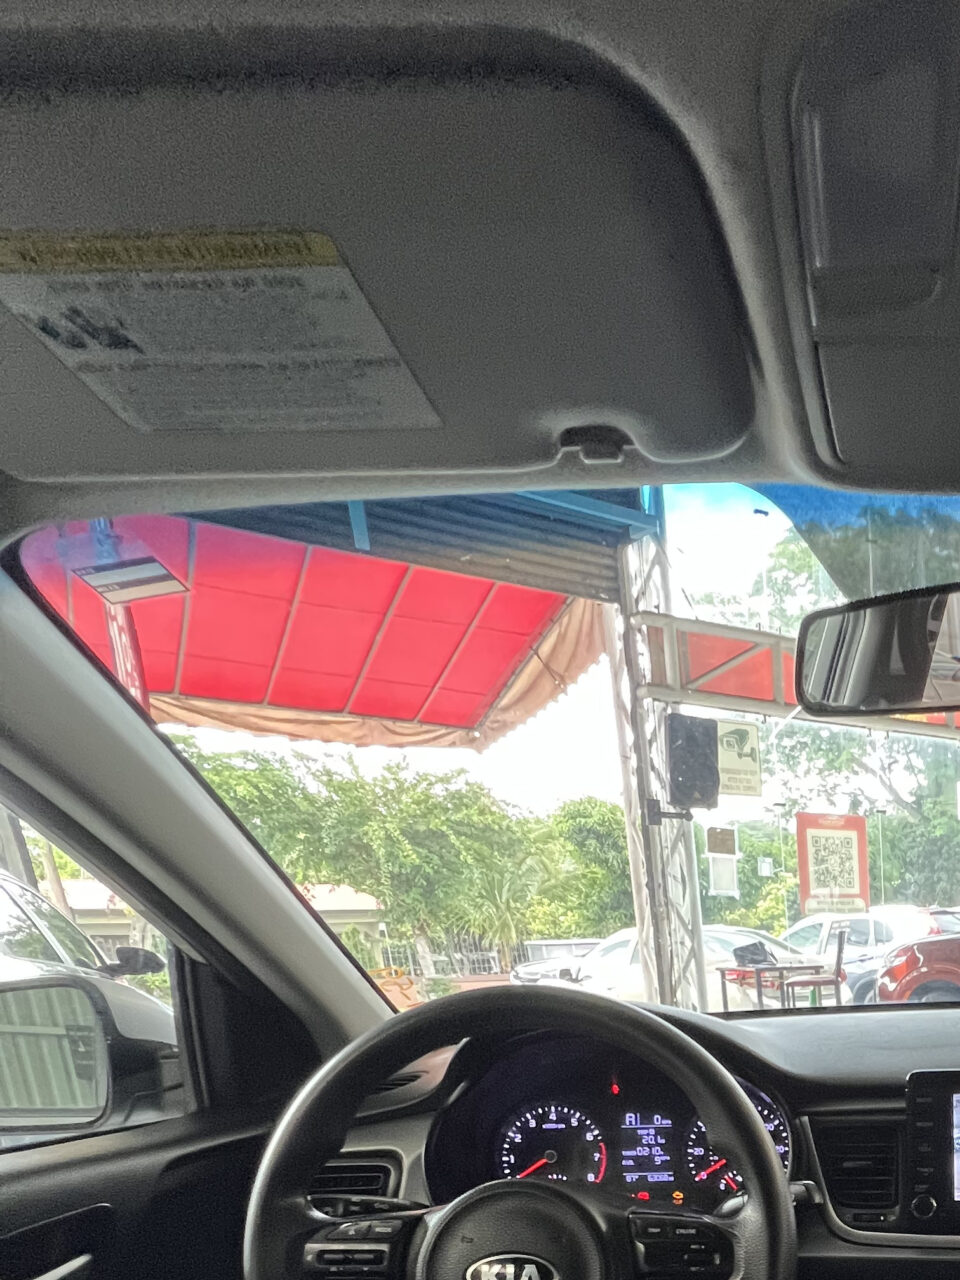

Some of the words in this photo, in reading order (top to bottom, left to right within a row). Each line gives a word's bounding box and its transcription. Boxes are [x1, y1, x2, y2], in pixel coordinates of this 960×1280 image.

[548, 1112, 557, 1121] 4
[653, 1114, 662, 1125] 0
[528, 1119, 537, 1128] 3
[570, 1118, 579, 1127] 5
[514, 1133, 522, 1142] 2
[585, 1132, 594, 1141] 6
[693, 1147, 704, 1155] 20
[509, 1154, 515, 1164] 1
[593, 1152, 600, 1162] 7
